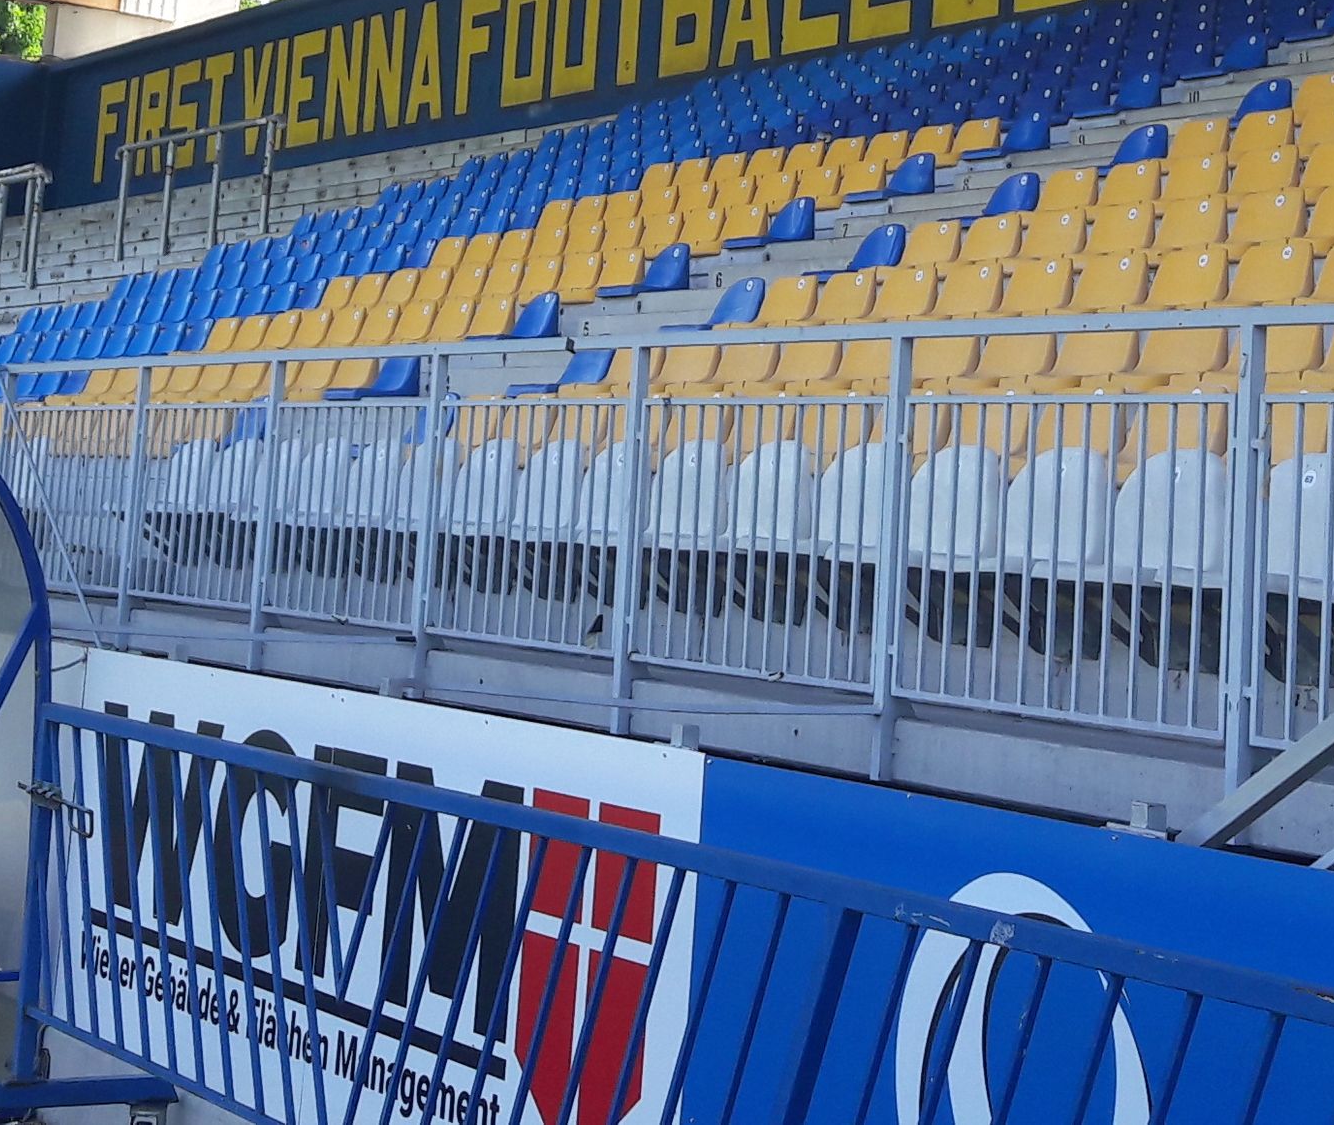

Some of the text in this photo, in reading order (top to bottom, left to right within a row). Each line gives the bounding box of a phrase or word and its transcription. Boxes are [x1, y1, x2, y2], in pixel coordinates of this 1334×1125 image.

[93, 51, 235, 183] FIRST
[243, 1, 441, 157] VIENNA
[842, 223, 849, 238] 7
[715, 272, 723, 288] 6
[582, 321, 590, 337] 5
[104, 701, 525, 1043] WGFM
[227, 988, 240, 1034] &
